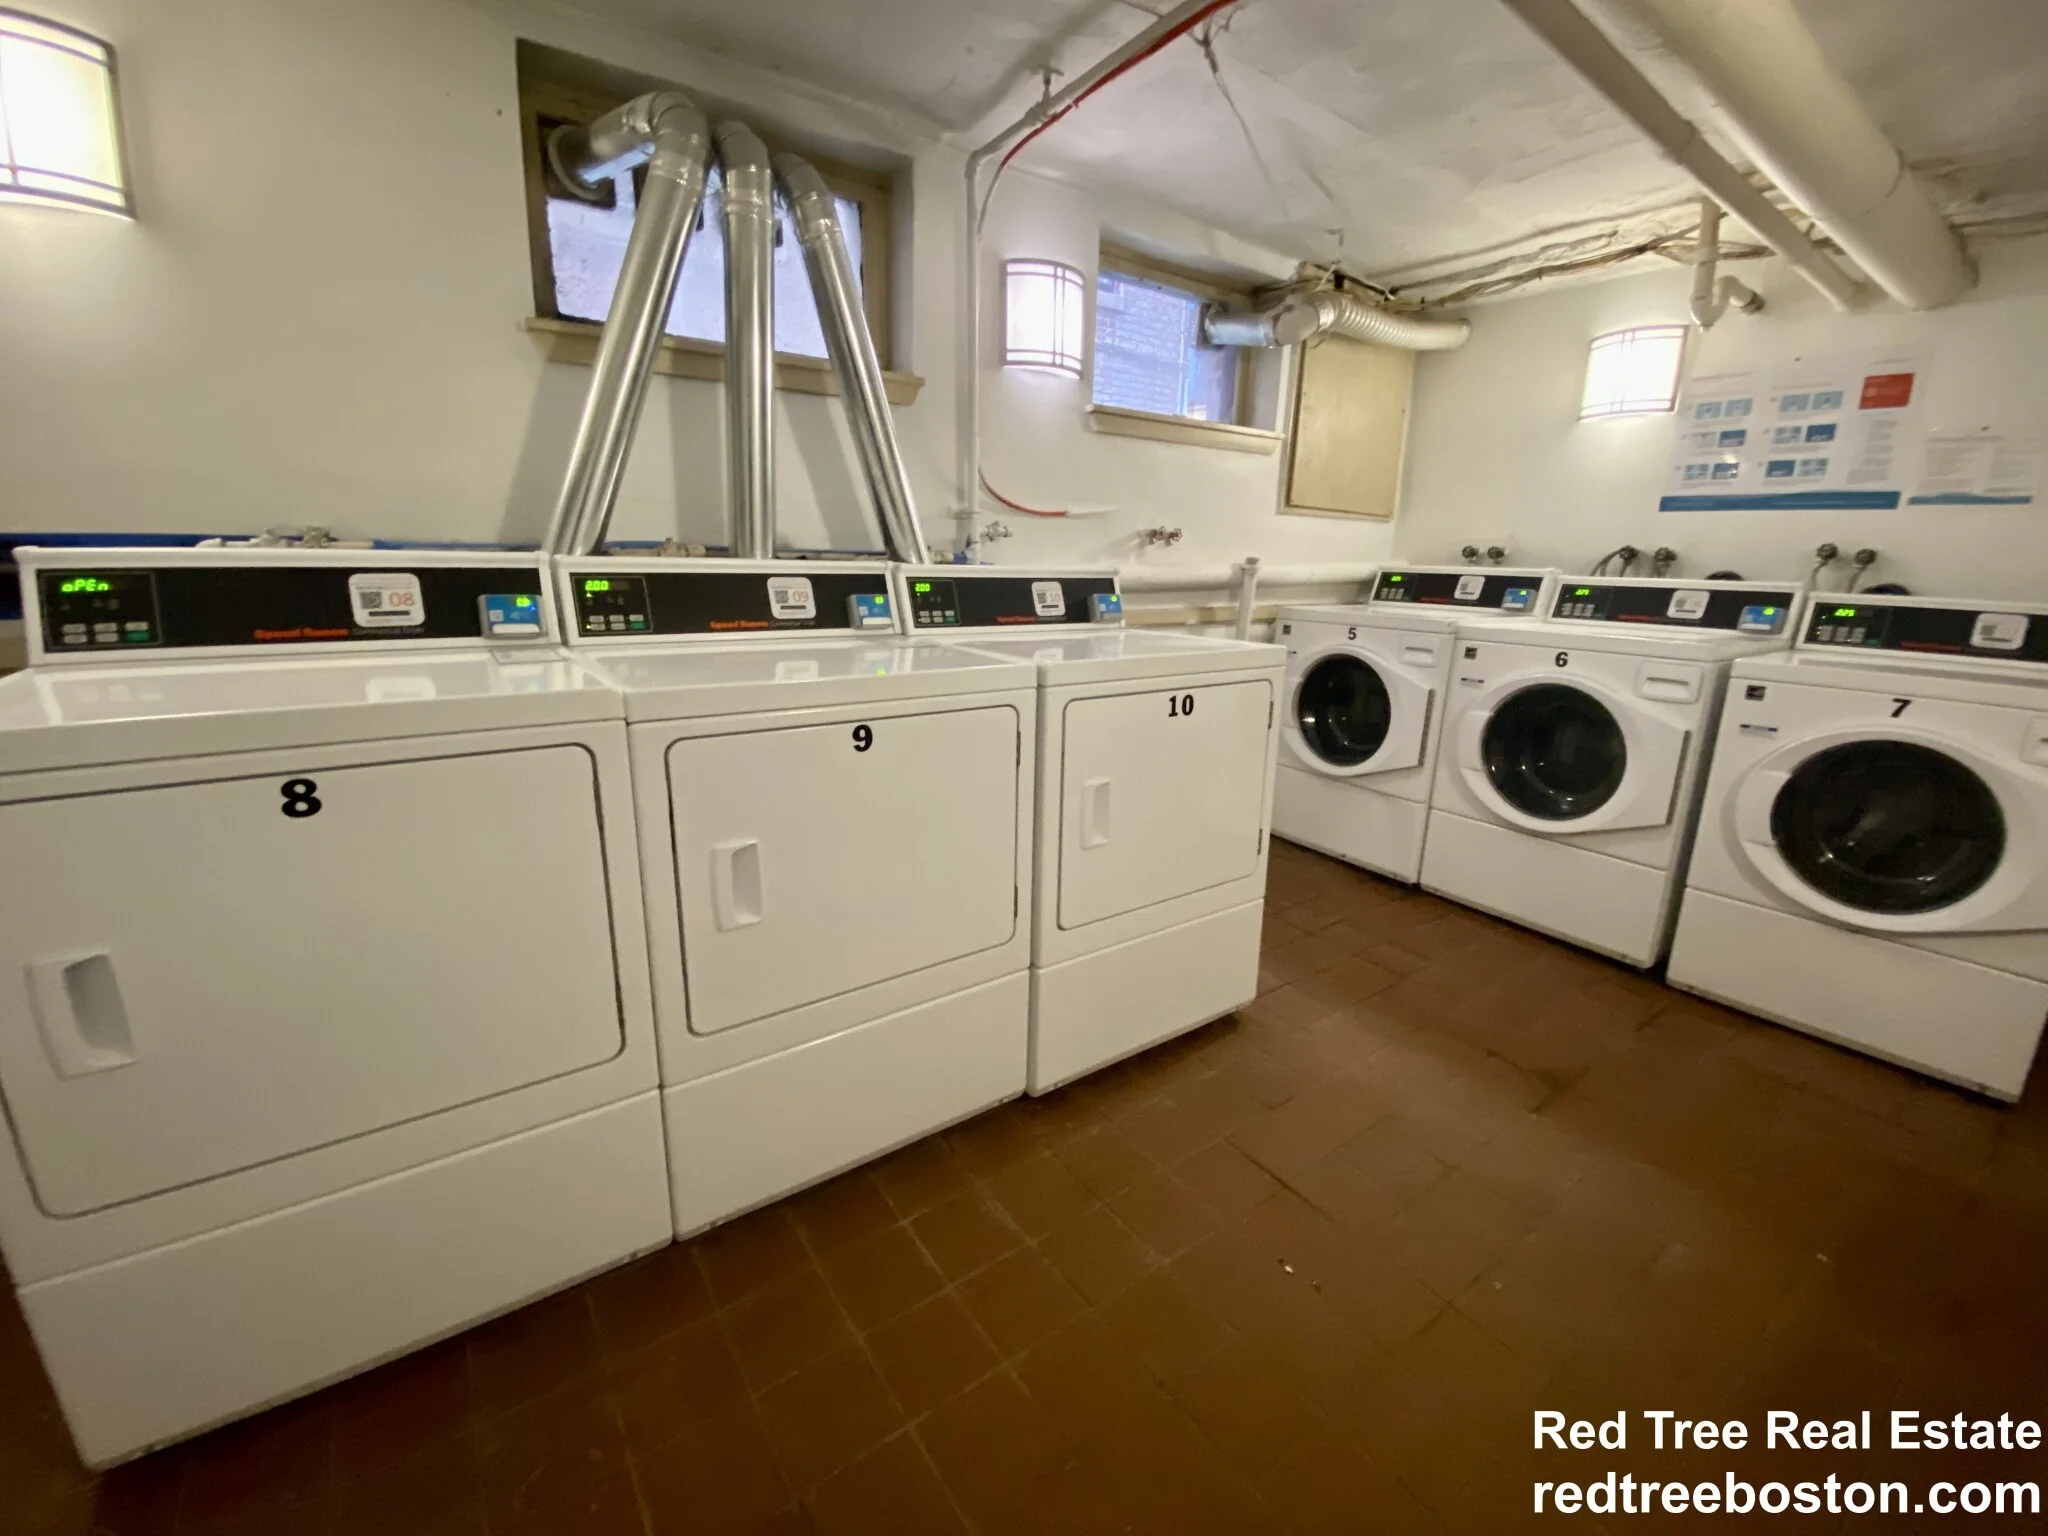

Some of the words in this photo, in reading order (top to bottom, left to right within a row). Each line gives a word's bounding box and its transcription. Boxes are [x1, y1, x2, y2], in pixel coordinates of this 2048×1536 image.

[389, 592, 415, 607] 08
[1347, 627, 1357, 641] 5
[1554, 651, 1569, 668] 6
[1168, 694, 1194, 717] 10
[1890, 698, 1912, 719] 7
[852, 724, 873, 752] 9
[281, 778, 322, 818] 8
